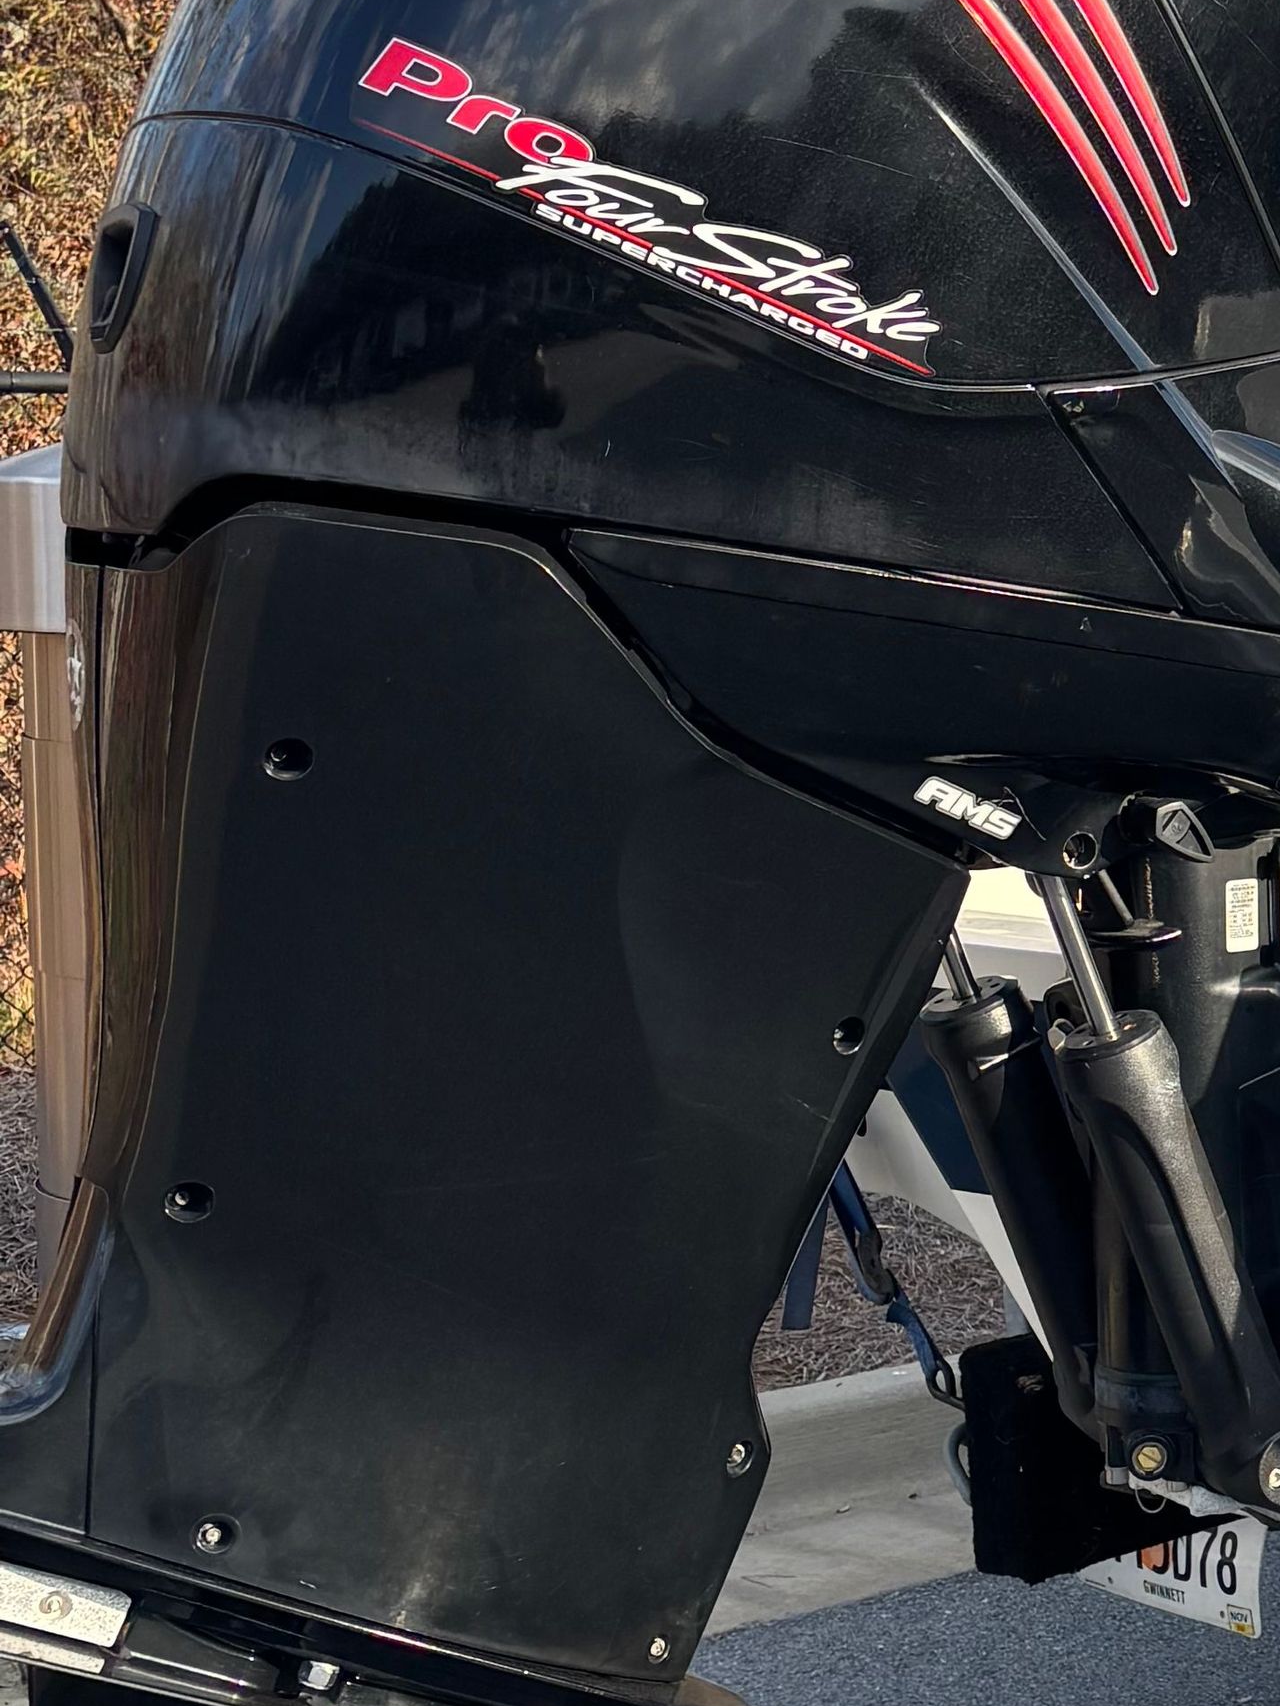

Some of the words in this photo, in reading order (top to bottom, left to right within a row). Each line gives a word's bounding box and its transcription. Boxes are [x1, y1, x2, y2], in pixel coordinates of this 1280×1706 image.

[359, 37, 594, 164] Pro
[535, 202, 869, 360] SUPERCHARGED
[914, 775, 1022, 840] AMS
[1143, 1579, 1185, 1605] GWINNETT
